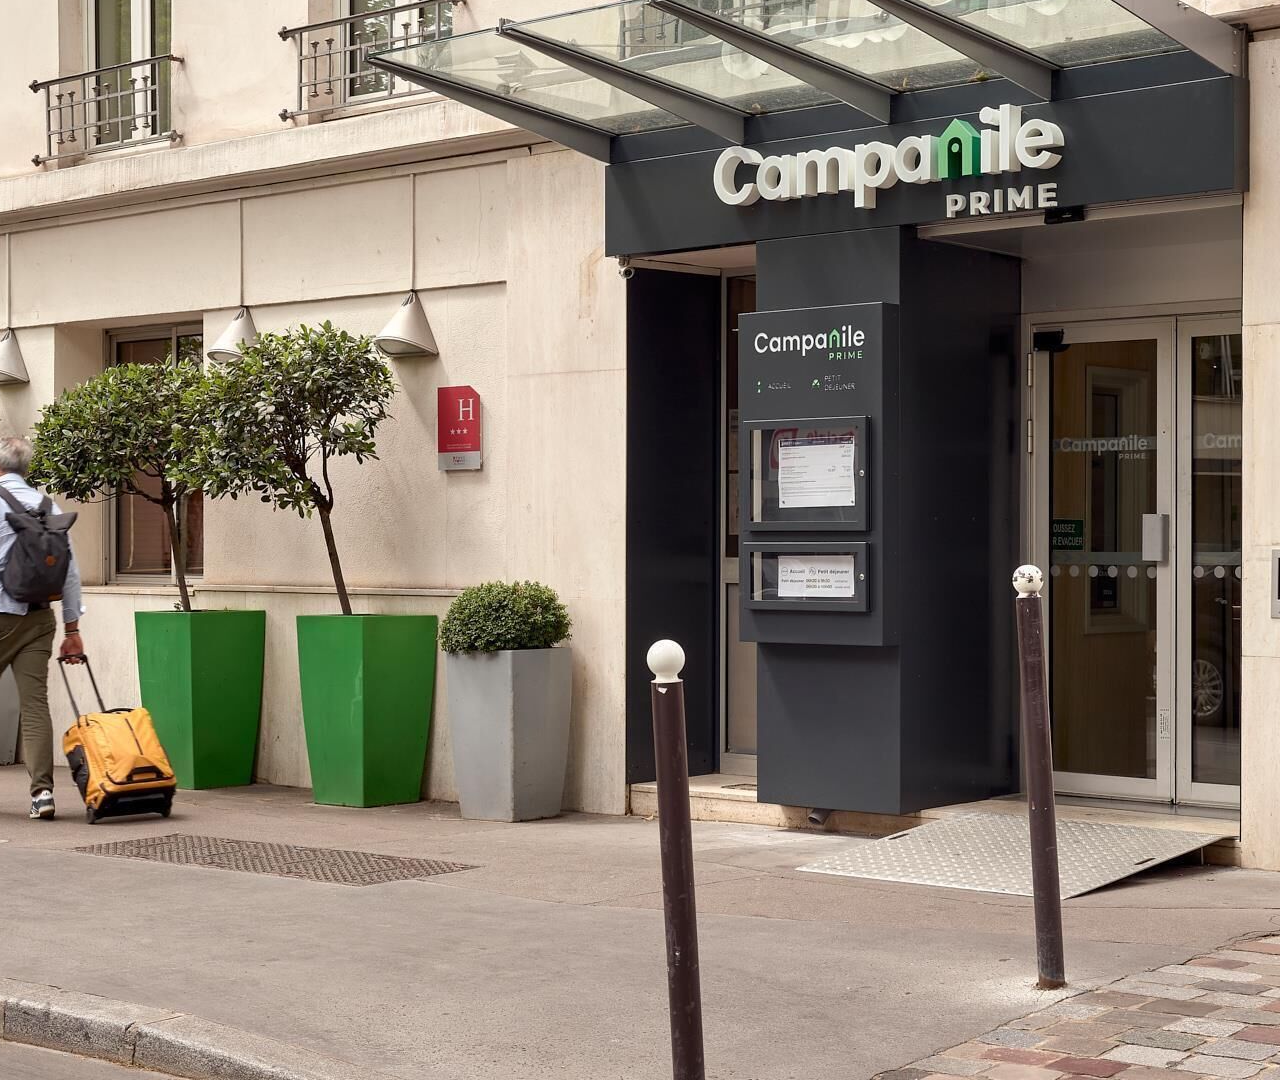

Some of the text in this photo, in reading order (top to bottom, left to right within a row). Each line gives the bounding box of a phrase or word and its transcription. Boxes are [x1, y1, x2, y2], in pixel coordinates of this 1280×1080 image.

[713, 103, 1065, 209] Campanile
[945, 182, 1059, 218] PRIME
[754, 324, 865, 357] Campanile
[828, 350, 863, 361] PRIME
[458, 398, 474, 421] H
[1059, 434, 1148, 456] Campanile
[1118, 452, 1147, 460] PRIME
